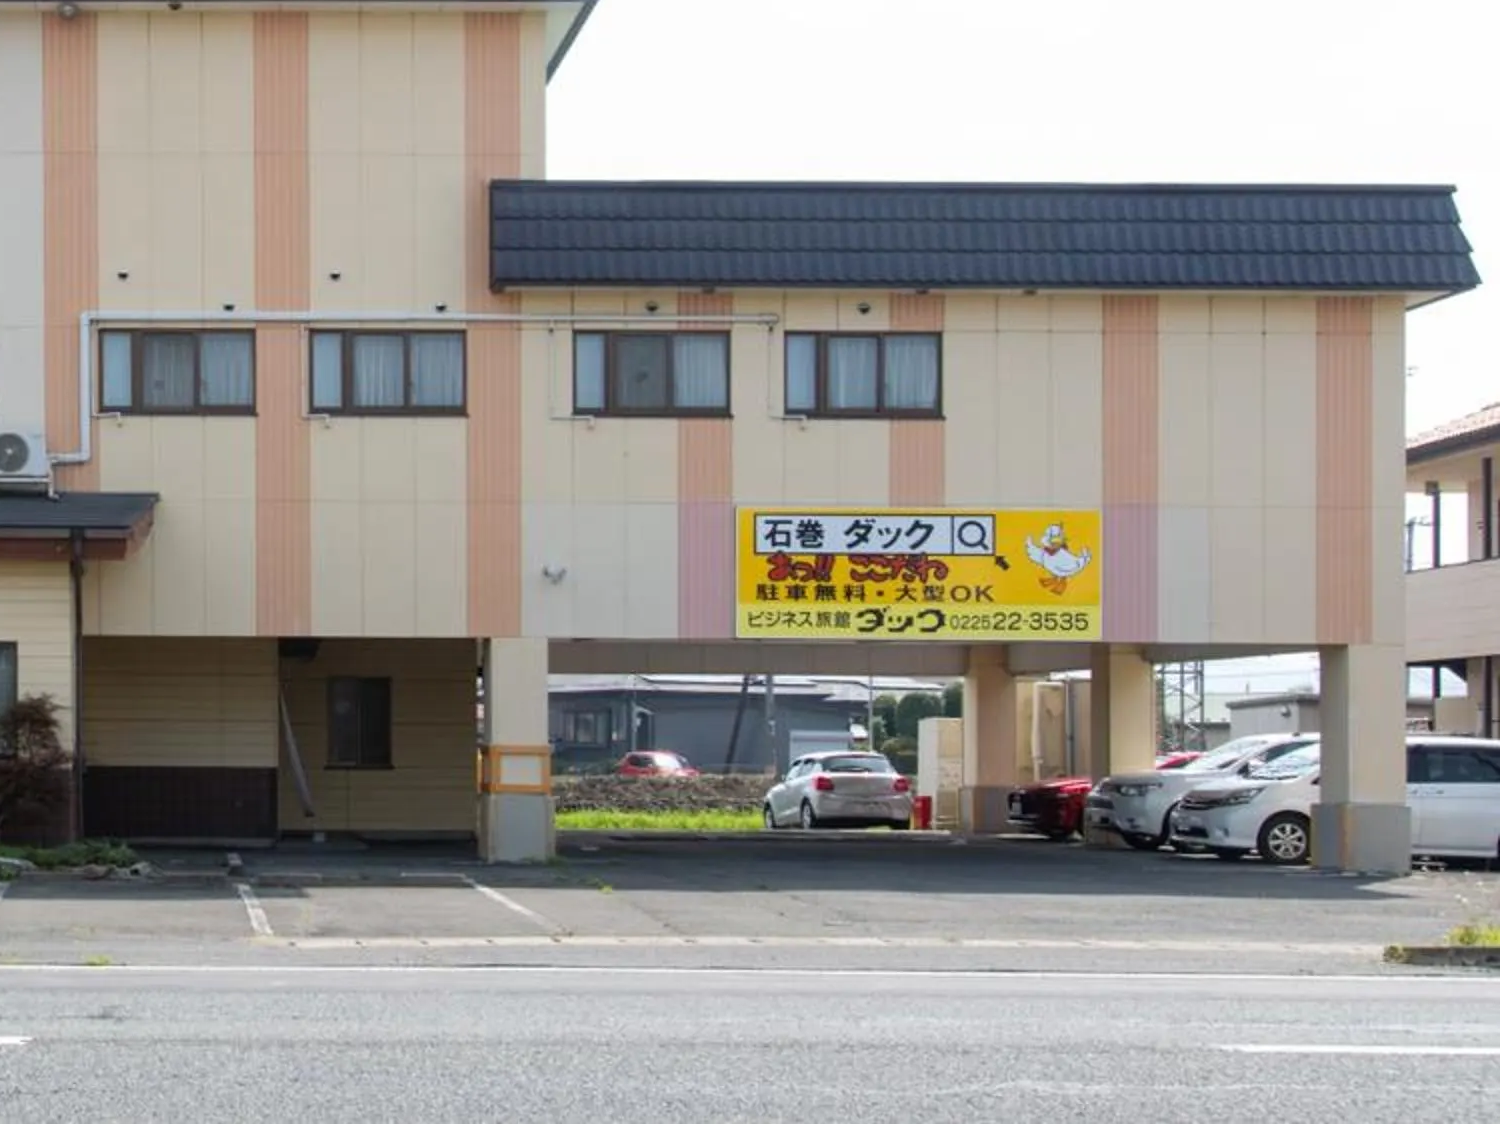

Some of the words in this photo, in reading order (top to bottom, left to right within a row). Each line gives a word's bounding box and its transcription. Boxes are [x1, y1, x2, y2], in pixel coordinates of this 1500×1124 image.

[763, 519, 825, 549] 石巻
[844, 518, 934, 550] ダック
